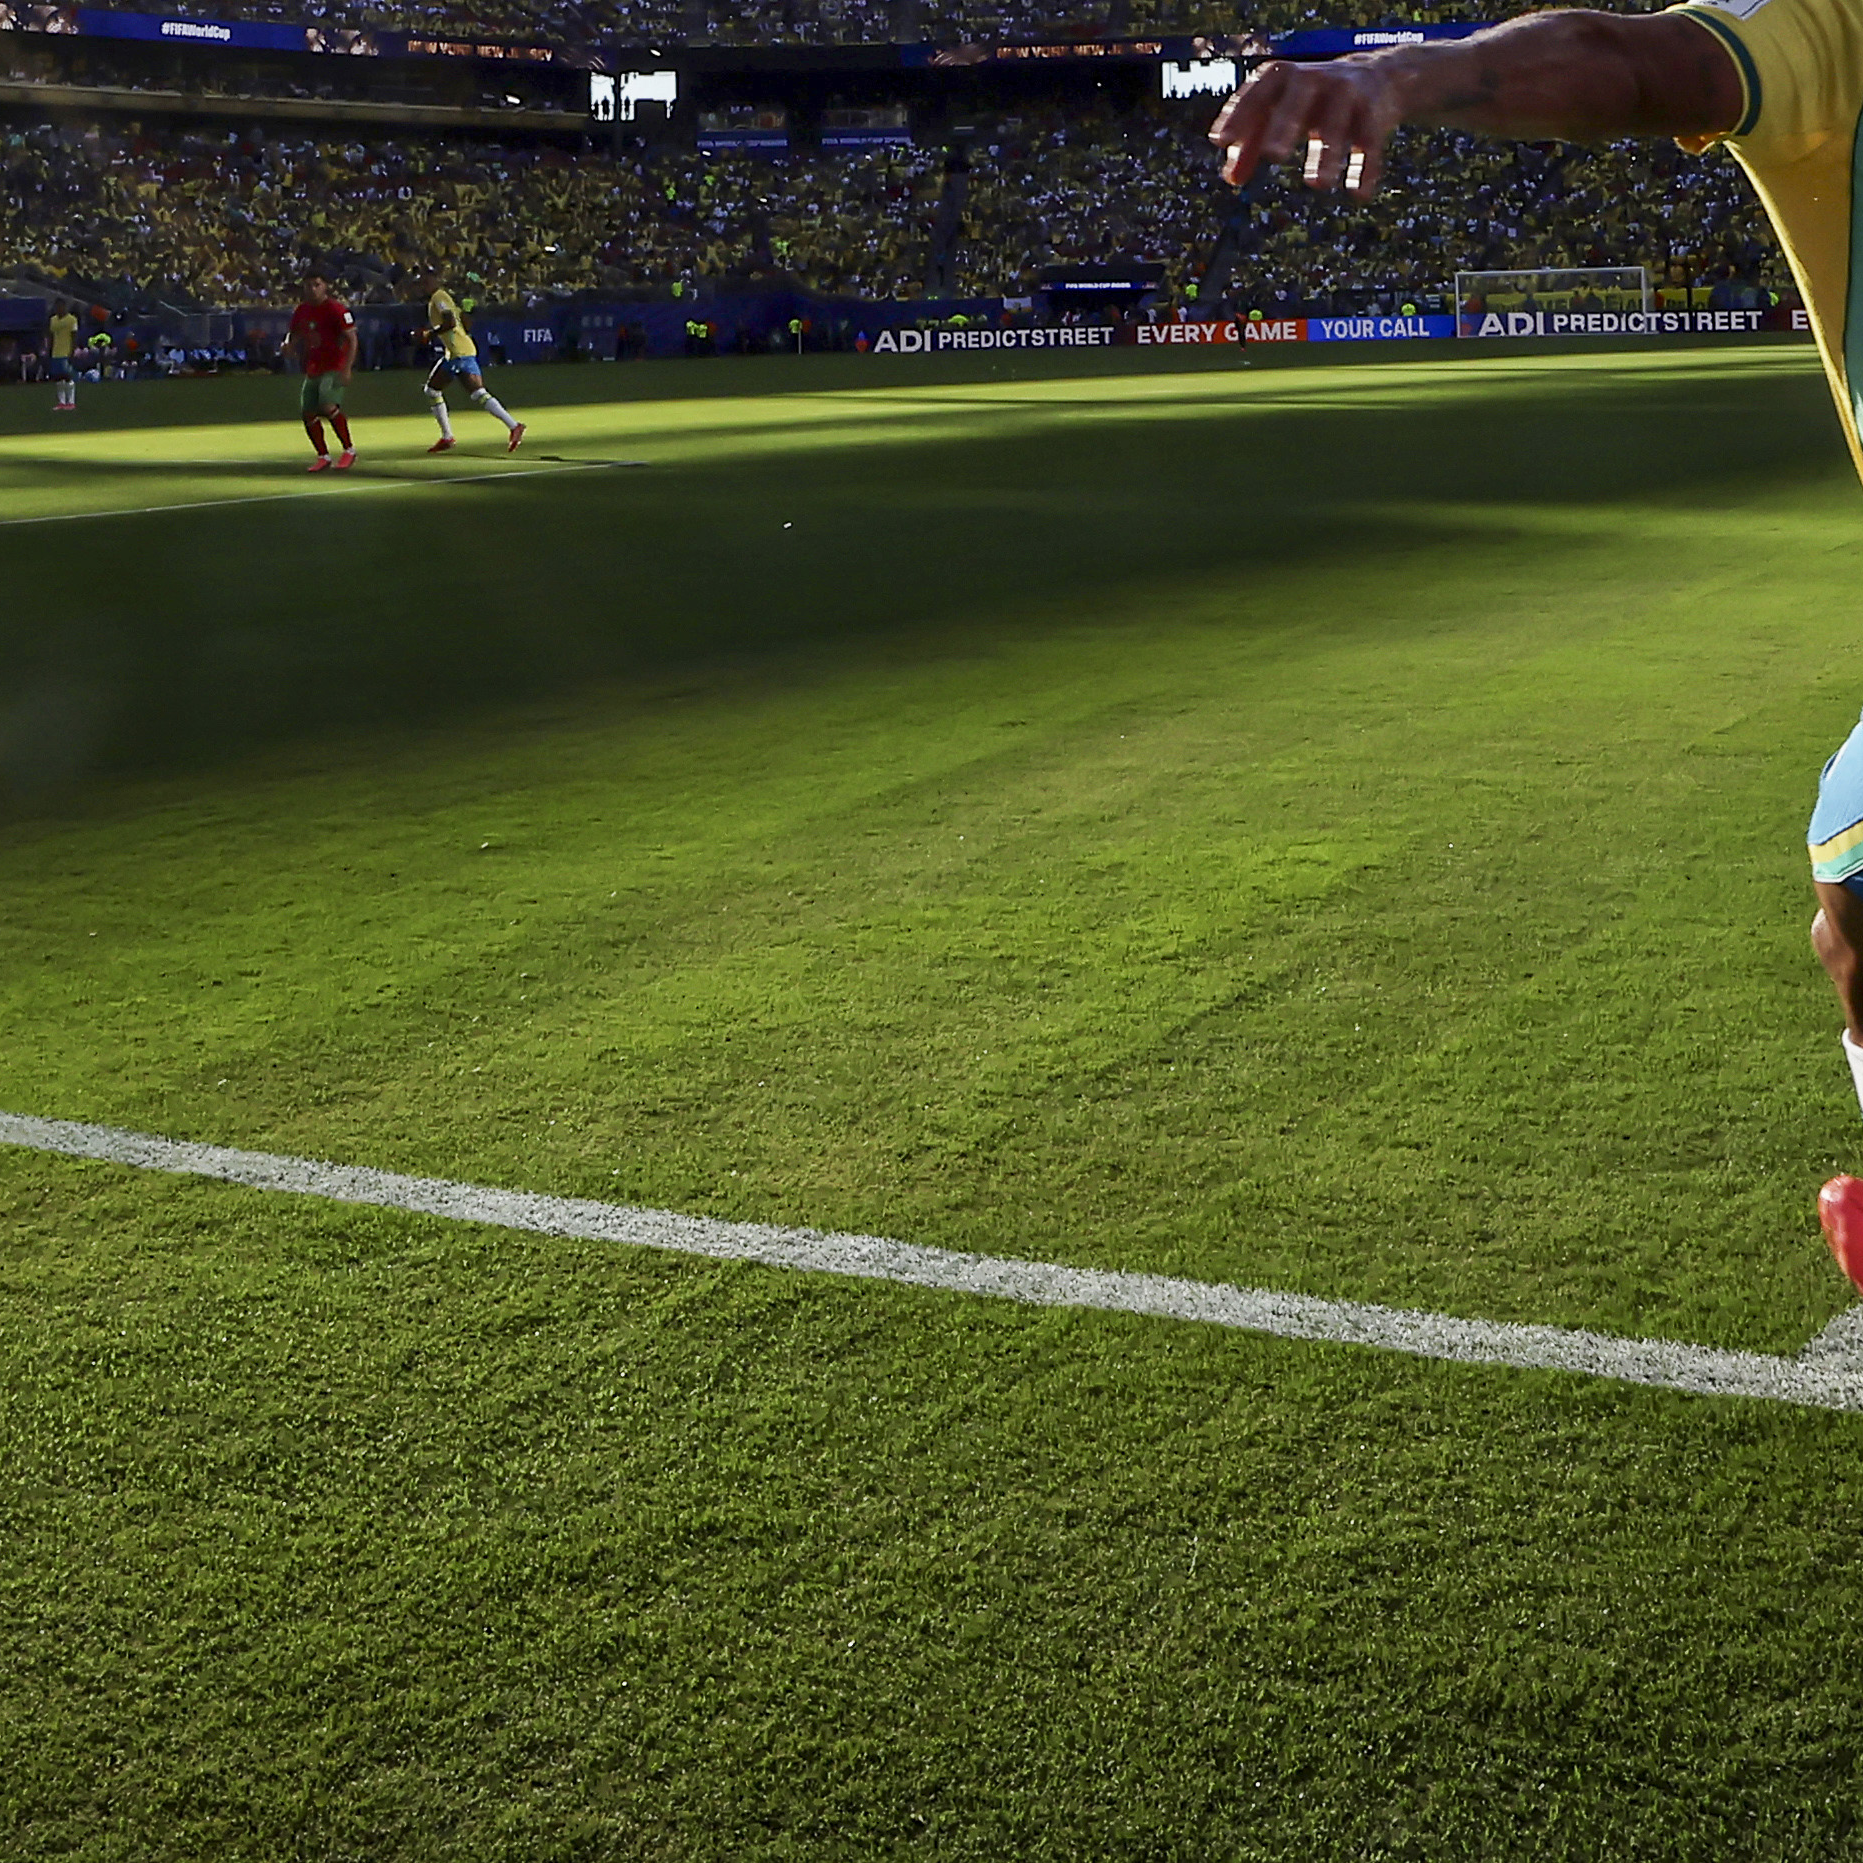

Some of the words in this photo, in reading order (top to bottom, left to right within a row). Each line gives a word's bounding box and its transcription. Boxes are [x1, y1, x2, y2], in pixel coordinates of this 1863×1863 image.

[161, 21, 231, 41] #FIFAWorldCup
[1354, 31, 1424, 45] #FIFAWorldCup
[1137, 322, 1219, 345] EVERY
[1223, 320, 1297, 342] GAME
[1321, 319, 1374, 339] YOUR
[1379, 317, 1430, 338] CALL
[1478, 312, 1545, 336] ADI
[1553, 310, 1764, 333] PREDICTSTREET
[523, 329, 553, 343] FIFA
[874, 329, 931, 353] ADI
[938, 326, 1114, 351] PREDICTSTREET
